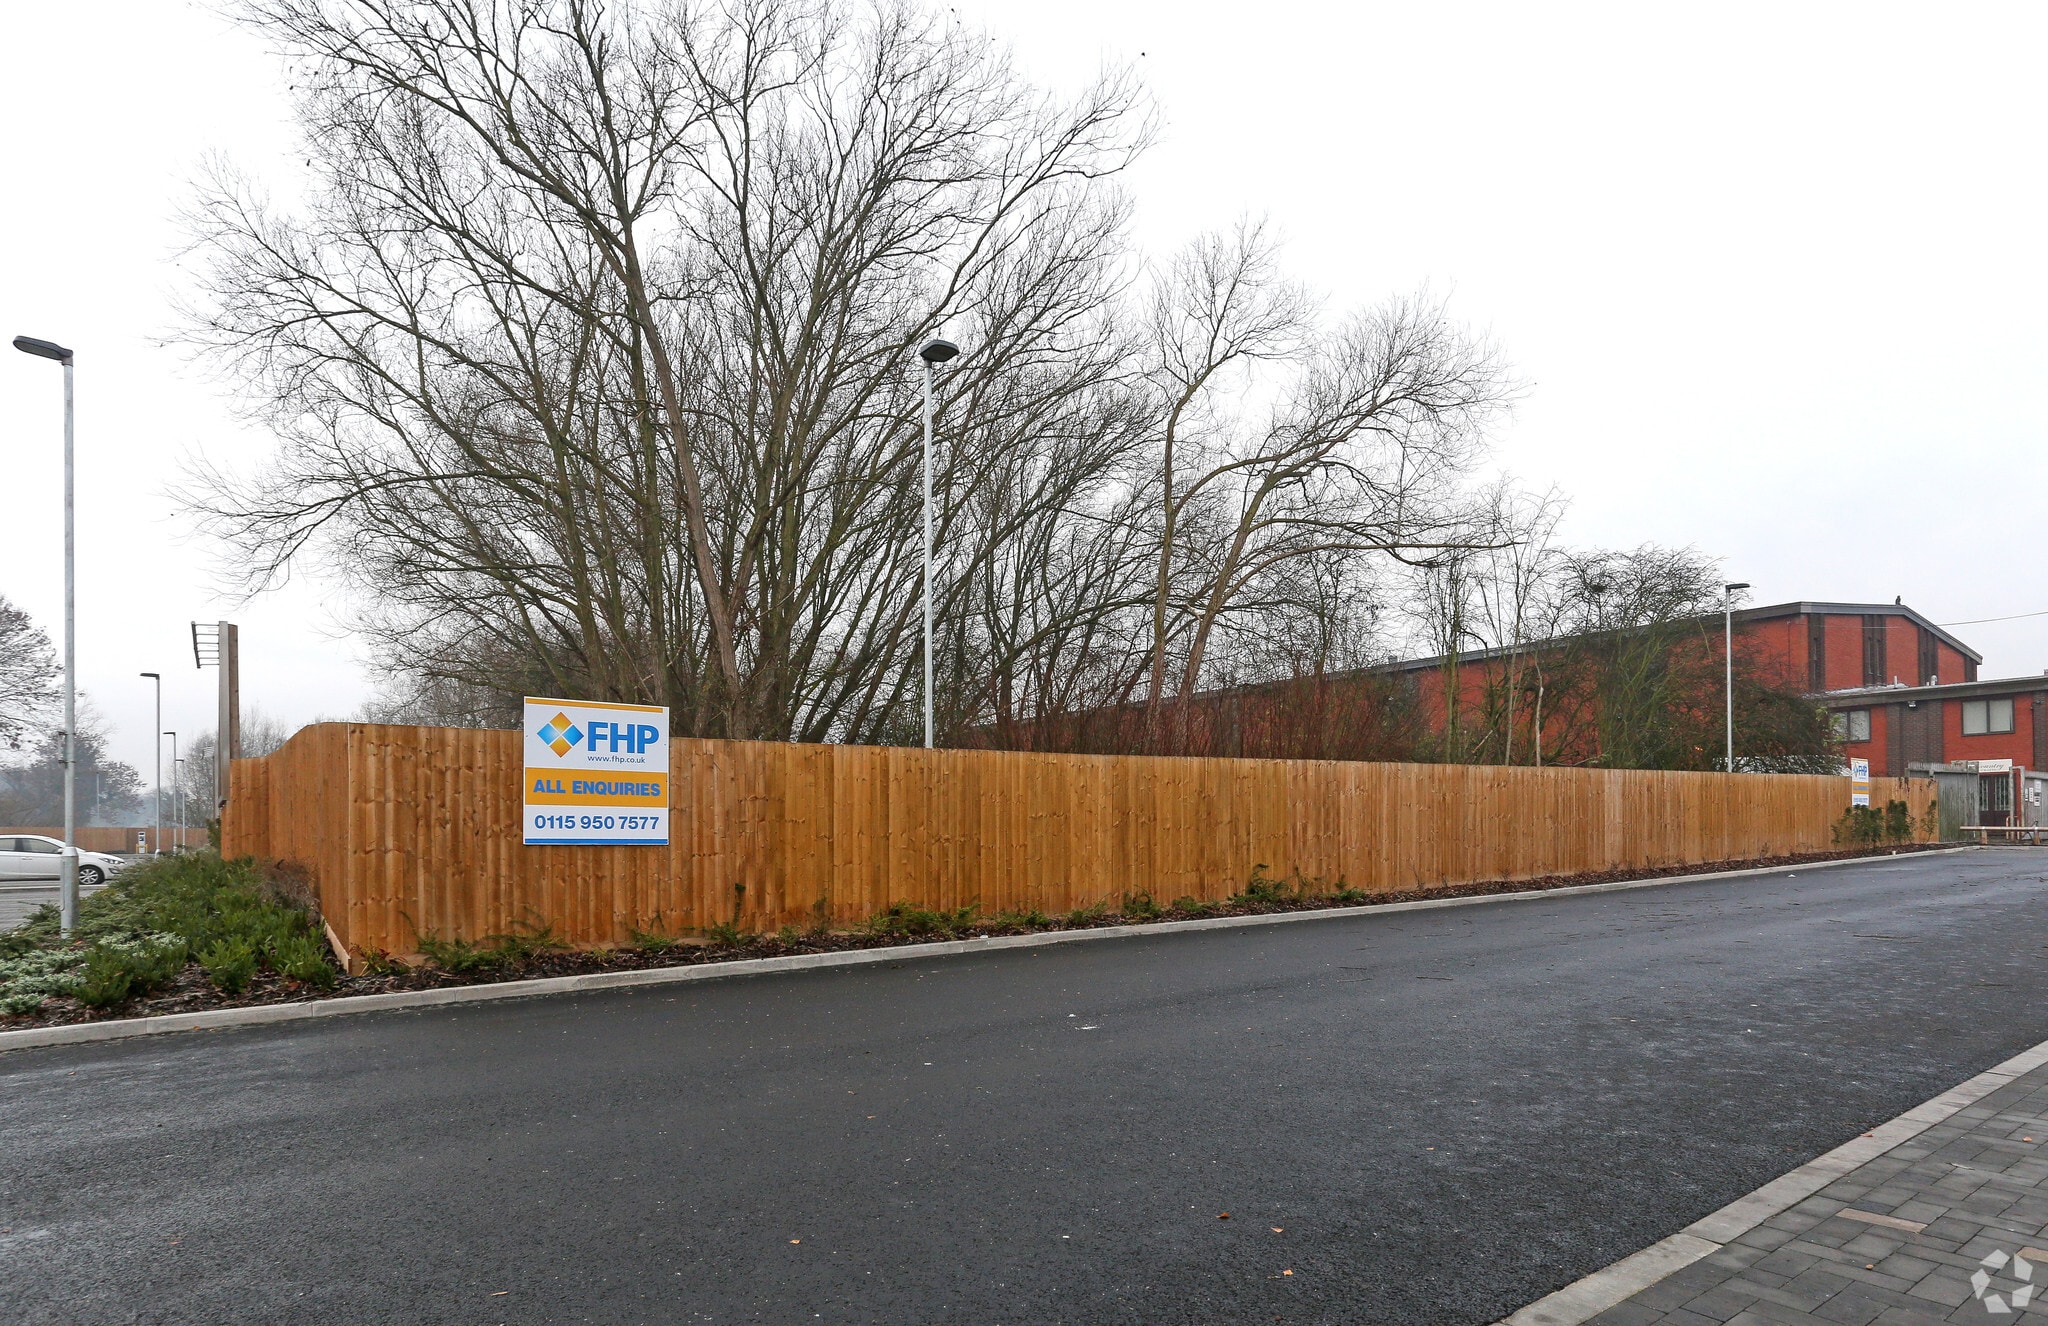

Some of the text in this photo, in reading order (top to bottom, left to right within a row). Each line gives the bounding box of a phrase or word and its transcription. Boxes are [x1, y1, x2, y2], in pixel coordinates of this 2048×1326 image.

[588, 721, 659, 754] FHP
[588, 755, 646, 764] www.fhp.co.uk
[533, 779, 661, 796] ALL ENQUIRIES
[534, 815, 660, 830] 0115 950 7577
